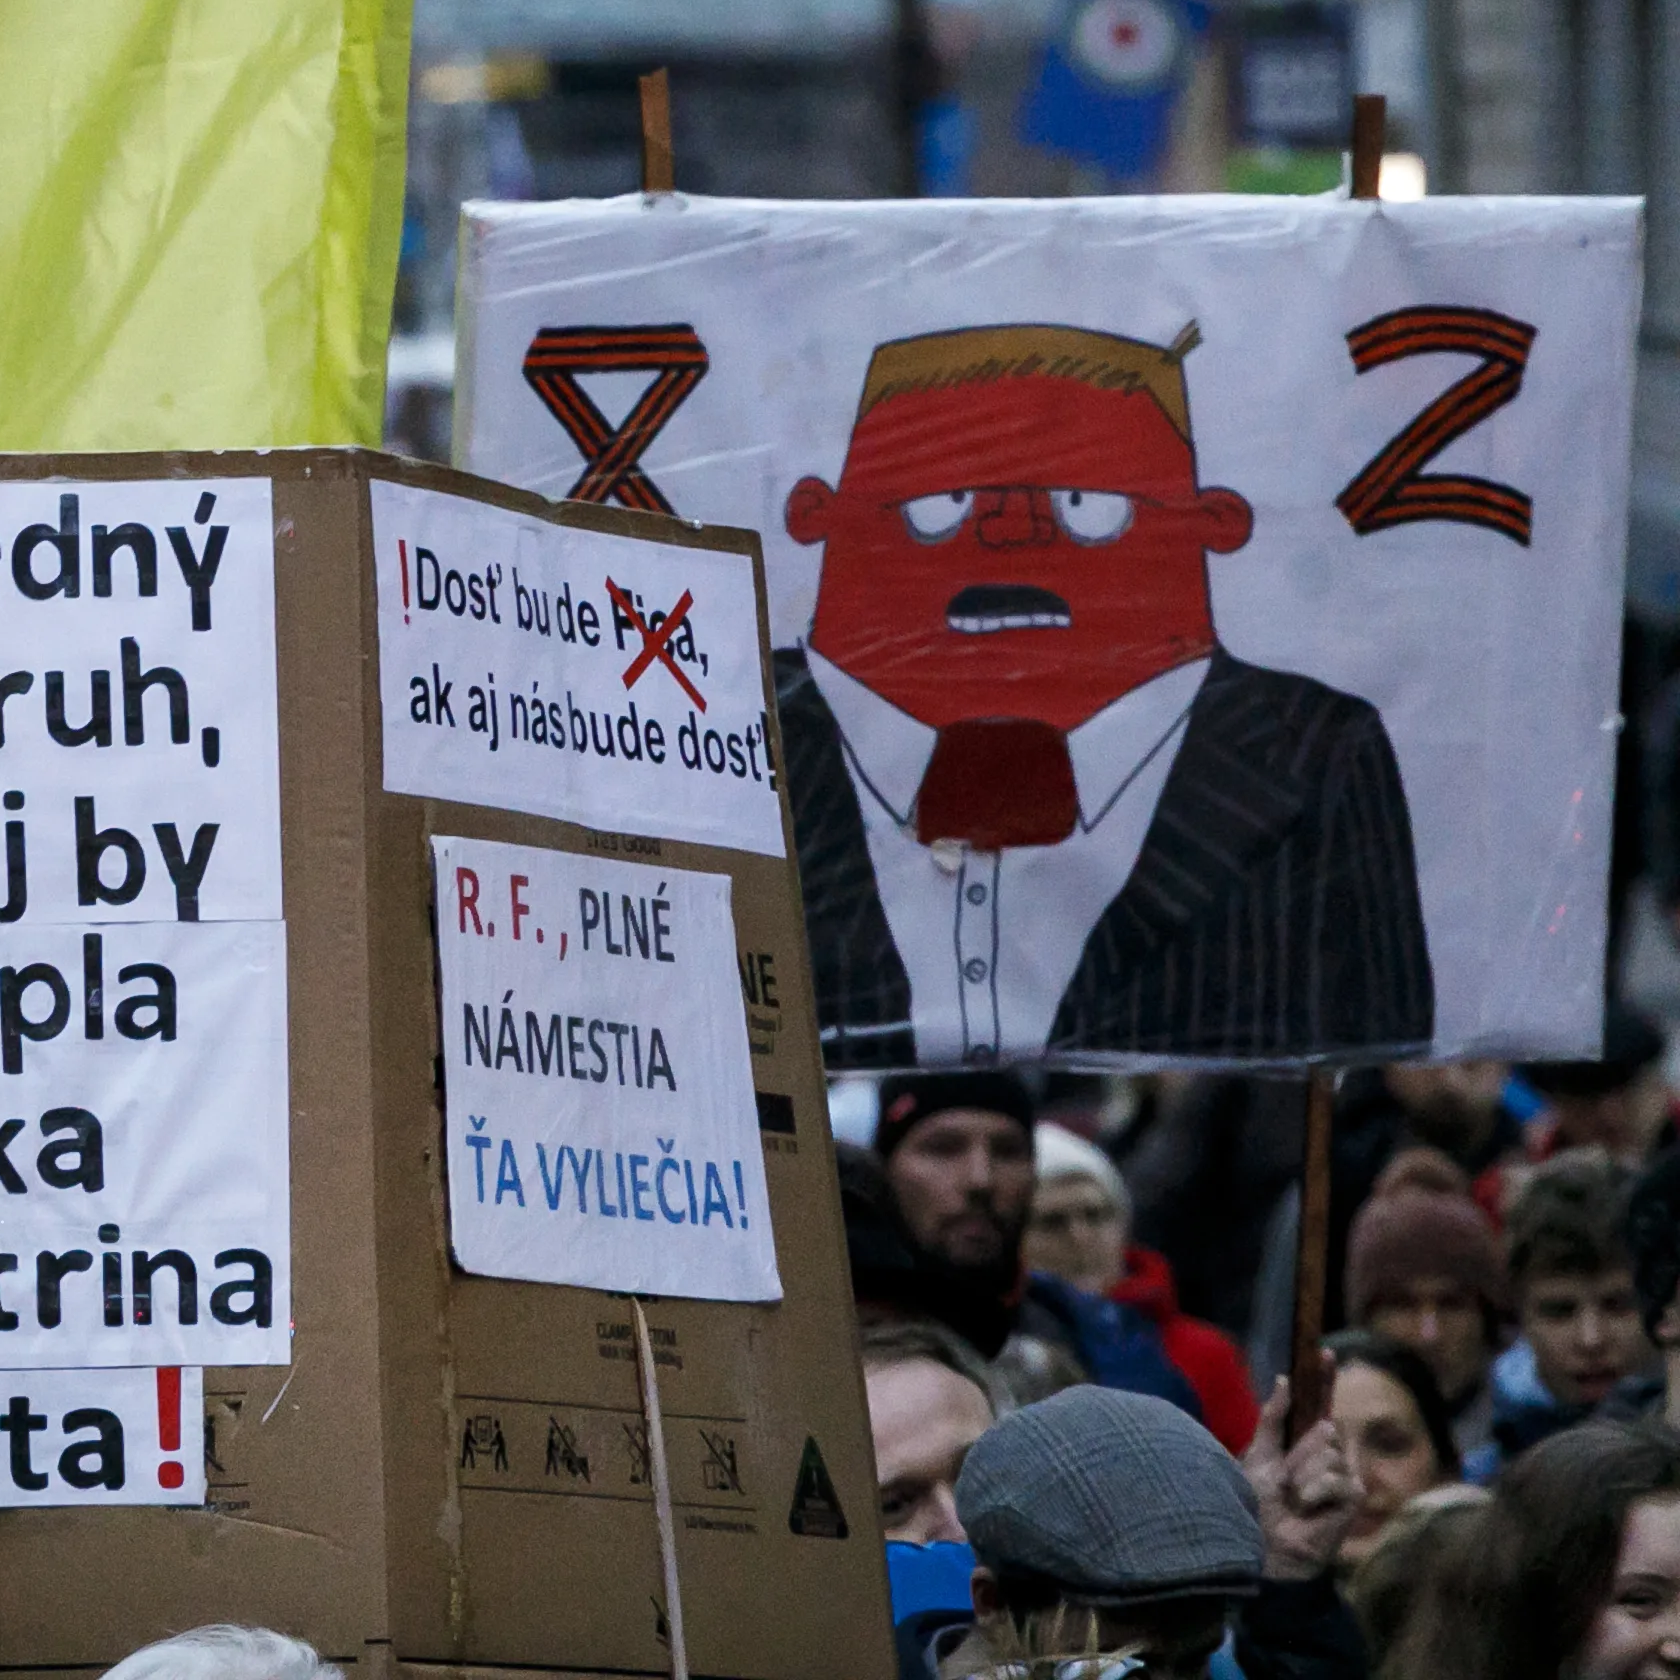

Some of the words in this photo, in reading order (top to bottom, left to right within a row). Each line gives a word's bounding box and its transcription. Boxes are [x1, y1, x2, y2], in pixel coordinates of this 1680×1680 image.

[512, 566, 601, 647] bude
[409, 662, 458, 729] ak
[467, 672, 499, 753] aj
[677, 710, 779, 792] dosť!
[75, 796, 220, 921] by
[579, 880, 676, 963] PLNÉ
[463, 989, 677, 1092] NÁMESTIA
[465, 1114, 526, 1208] ŤA
[536, 1136, 749, 1231] VYLIEČIA!
